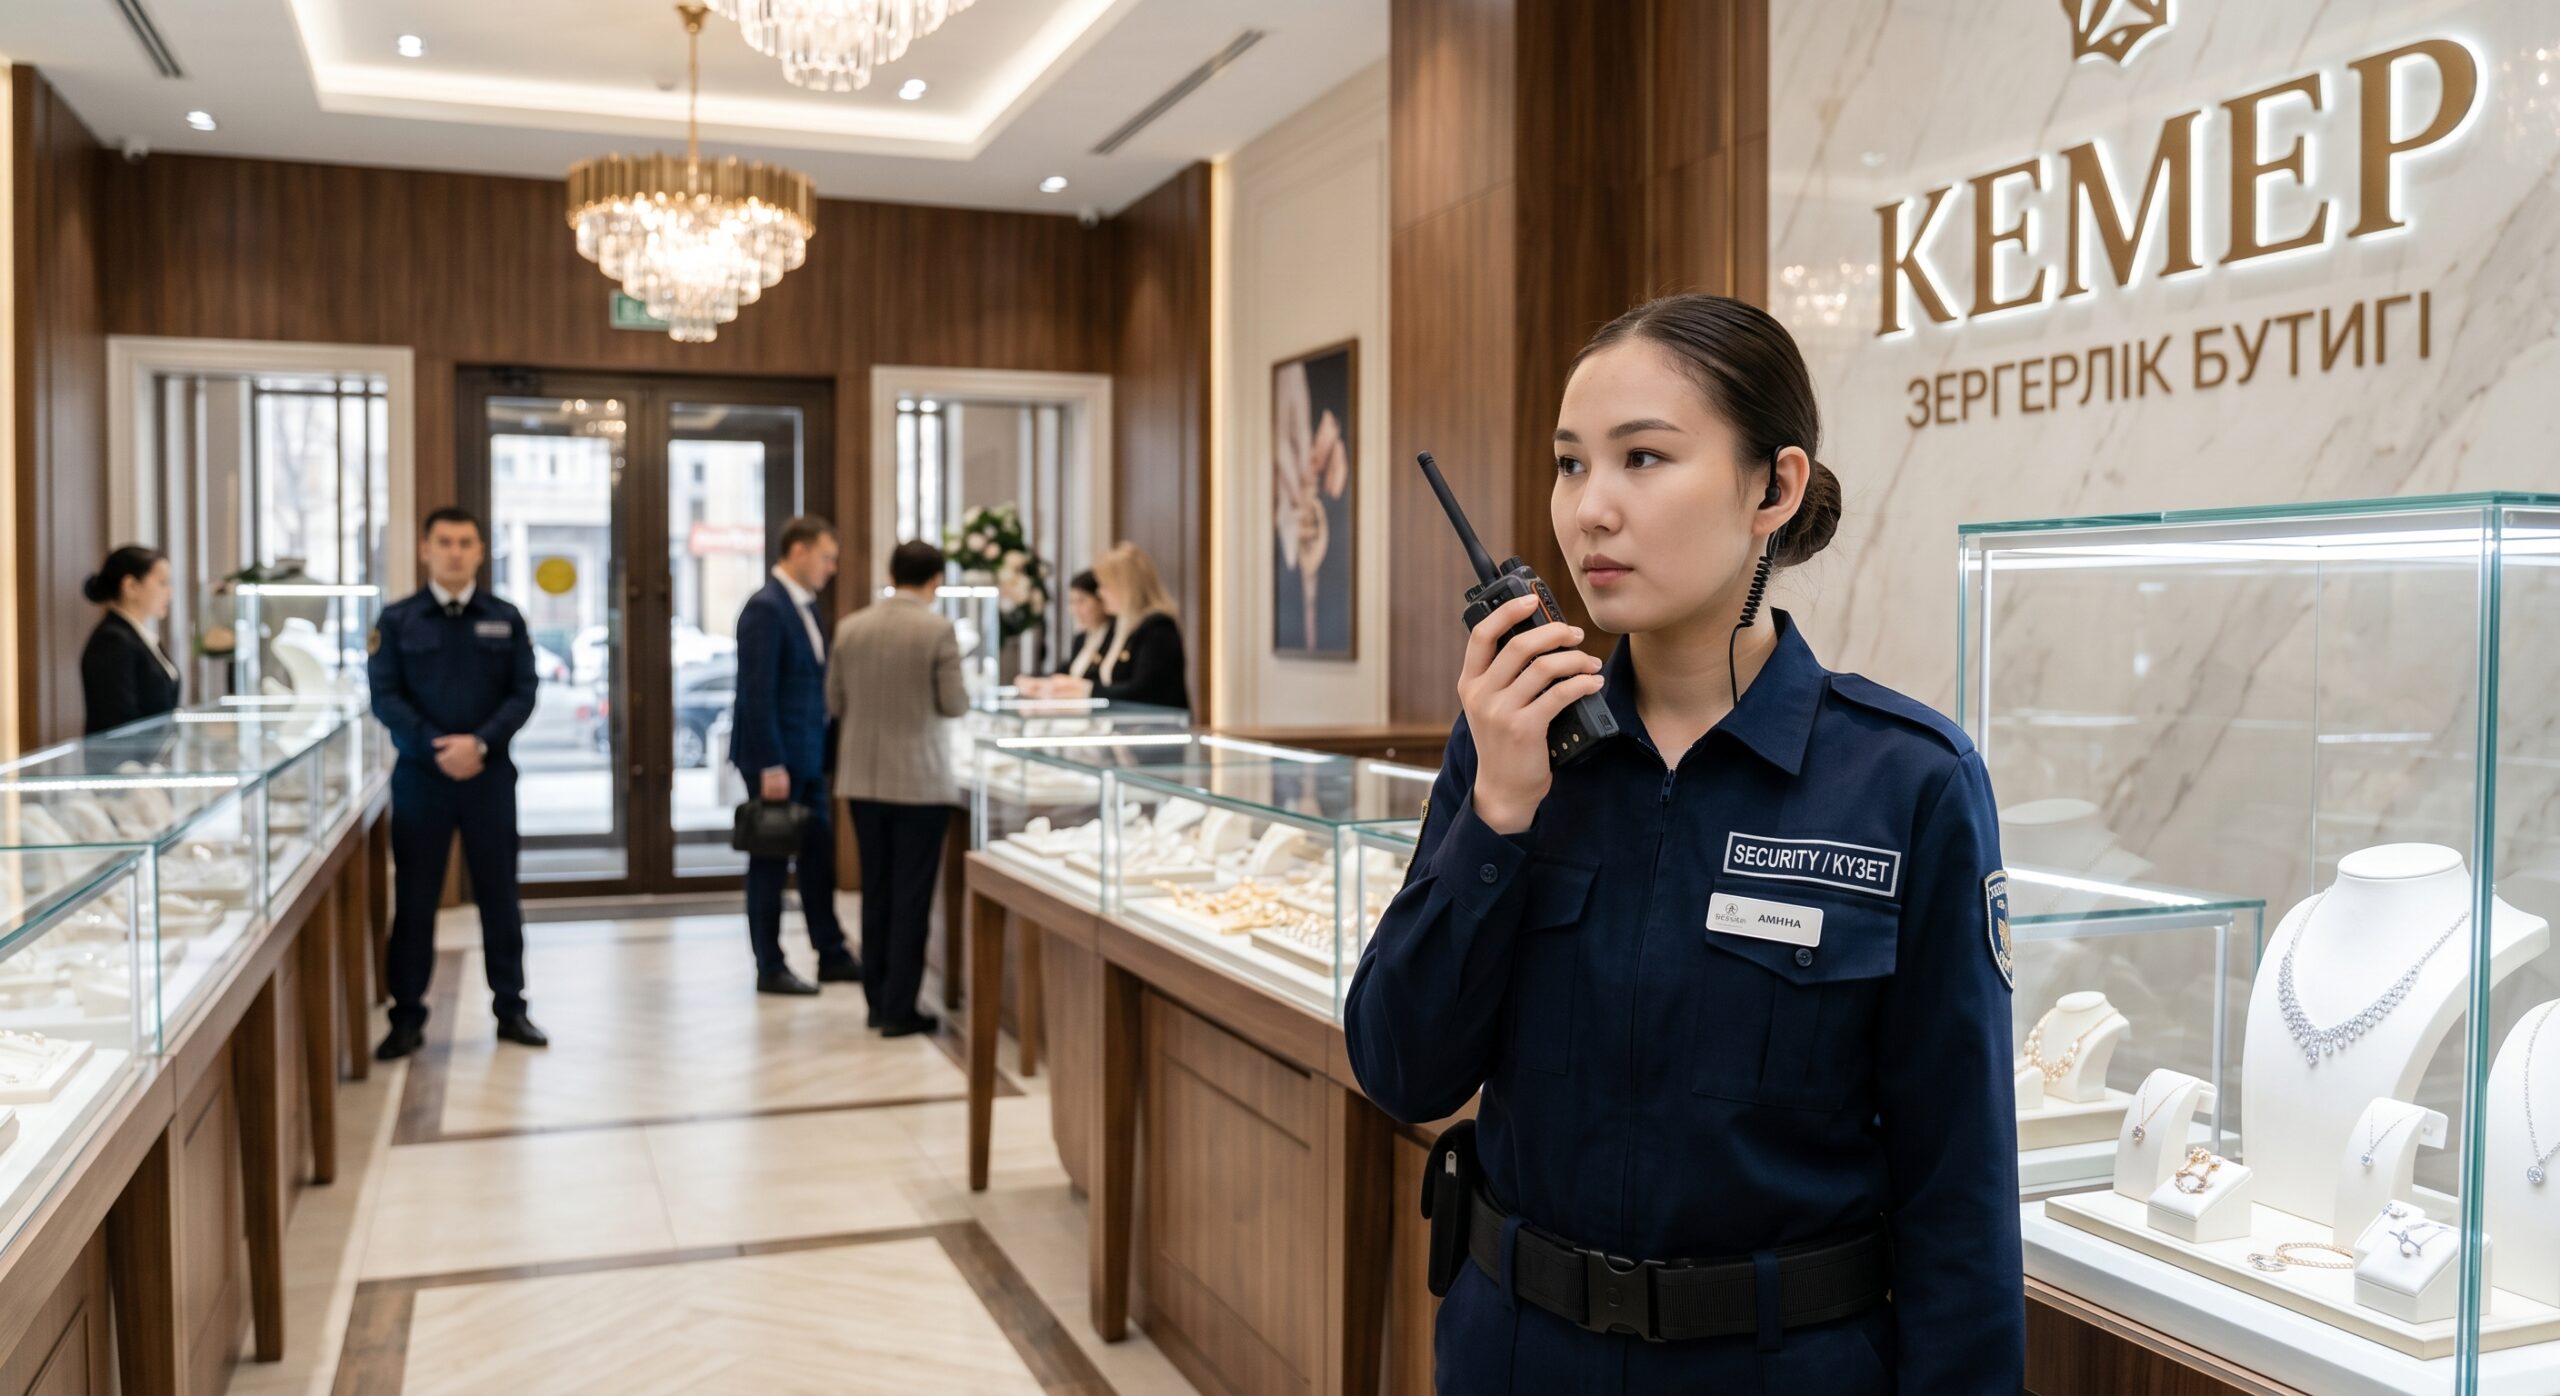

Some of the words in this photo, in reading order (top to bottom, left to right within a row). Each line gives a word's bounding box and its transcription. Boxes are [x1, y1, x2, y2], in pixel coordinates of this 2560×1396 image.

[1874, 38, 2479, 337] КЕМЕР
[1906, 335, 2173, 430] ЗЕРГЕРЛІК
[2194, 290, 2432, 390] БУТИГІ
[1734, 844, 1819, 870] SECURITY
[1821, 852, 1831, 873] /
